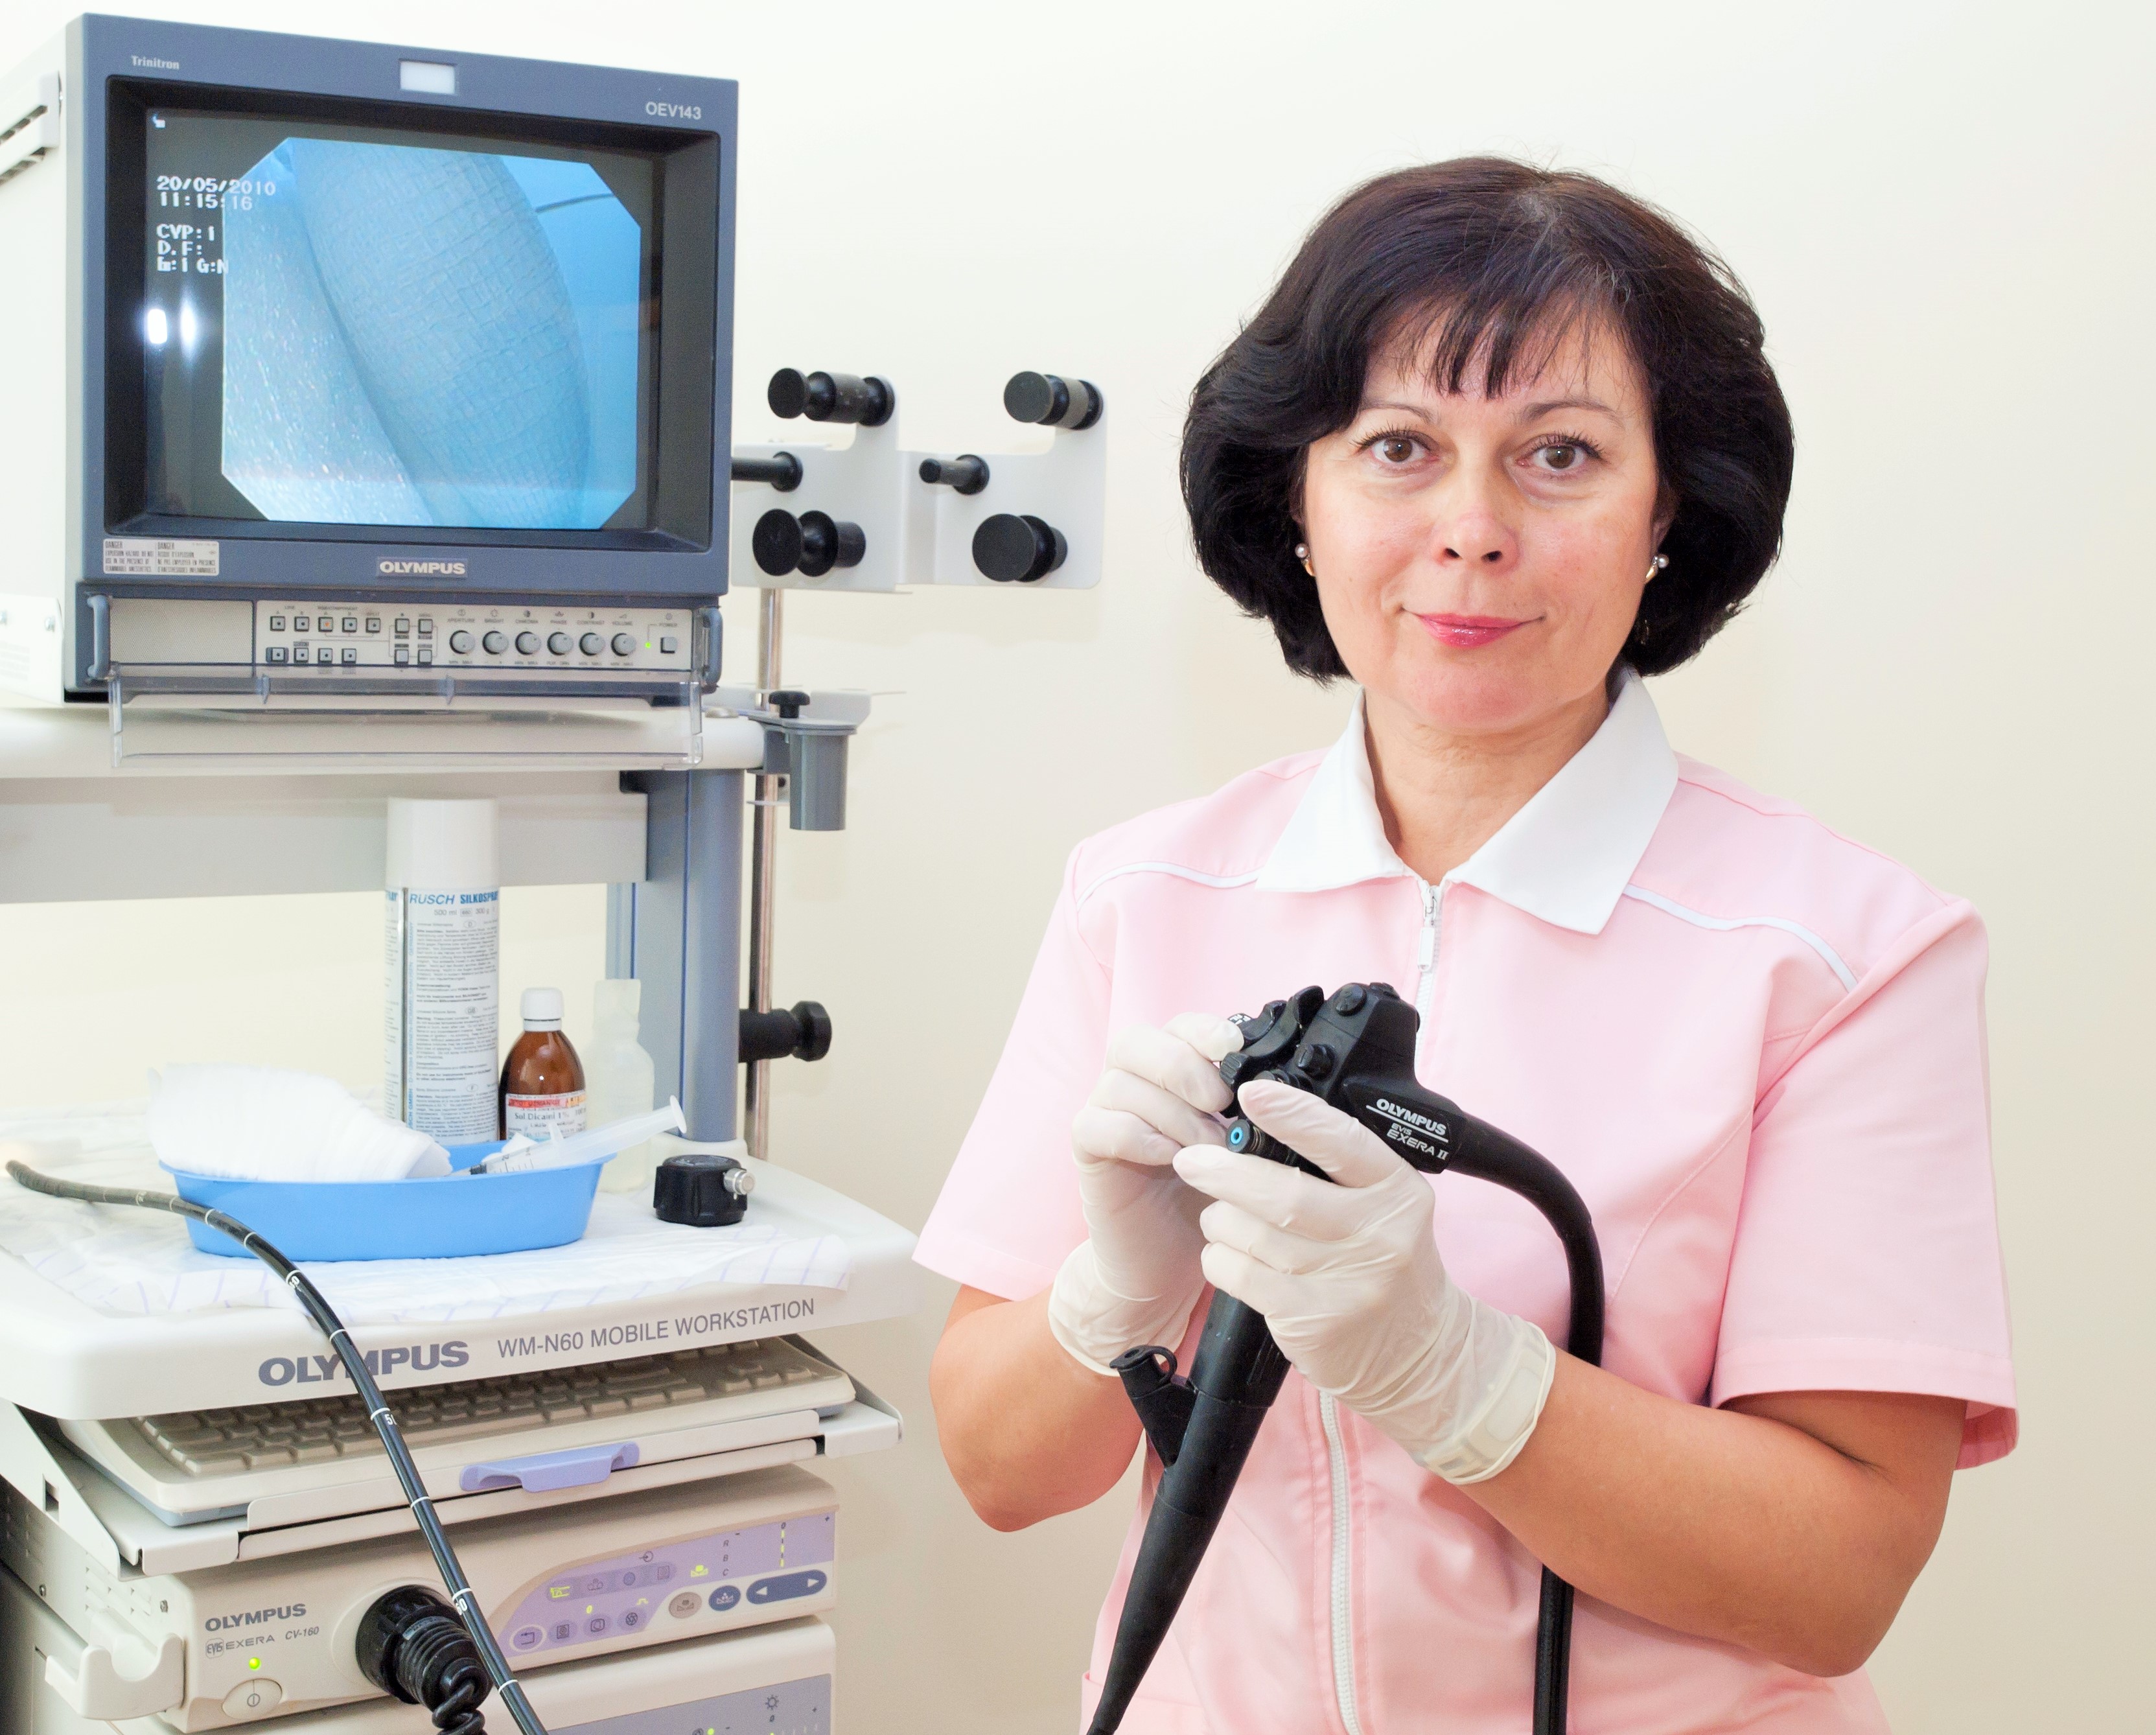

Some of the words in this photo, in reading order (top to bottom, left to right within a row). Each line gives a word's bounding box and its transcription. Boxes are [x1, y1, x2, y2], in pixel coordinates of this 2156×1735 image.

[131, 55, 180, 70] Trinitron
[645, 101, 702, 121] OEV143
[156, 175, 276, 195] 20/05/2010
[161, 192, 253, 211] 11:15:16
[380, 561, 466, 575] OLYMPUS
[1376, 1099, 1447, 1135] OLYMPUS
[1387, 1128, 1435, 1156] EXERA
[498, 1331, 584, 1358] WM-N60
[590, 1320, 669, 1347] MOBILE
[675, 1298, 815, 1336] WORKSTATION
[205, 1603, 307, 1632] OLYMPUS
[226, 1635, 275, 1649] EXERA
[285, 1626, 320, 1640] CV-160
